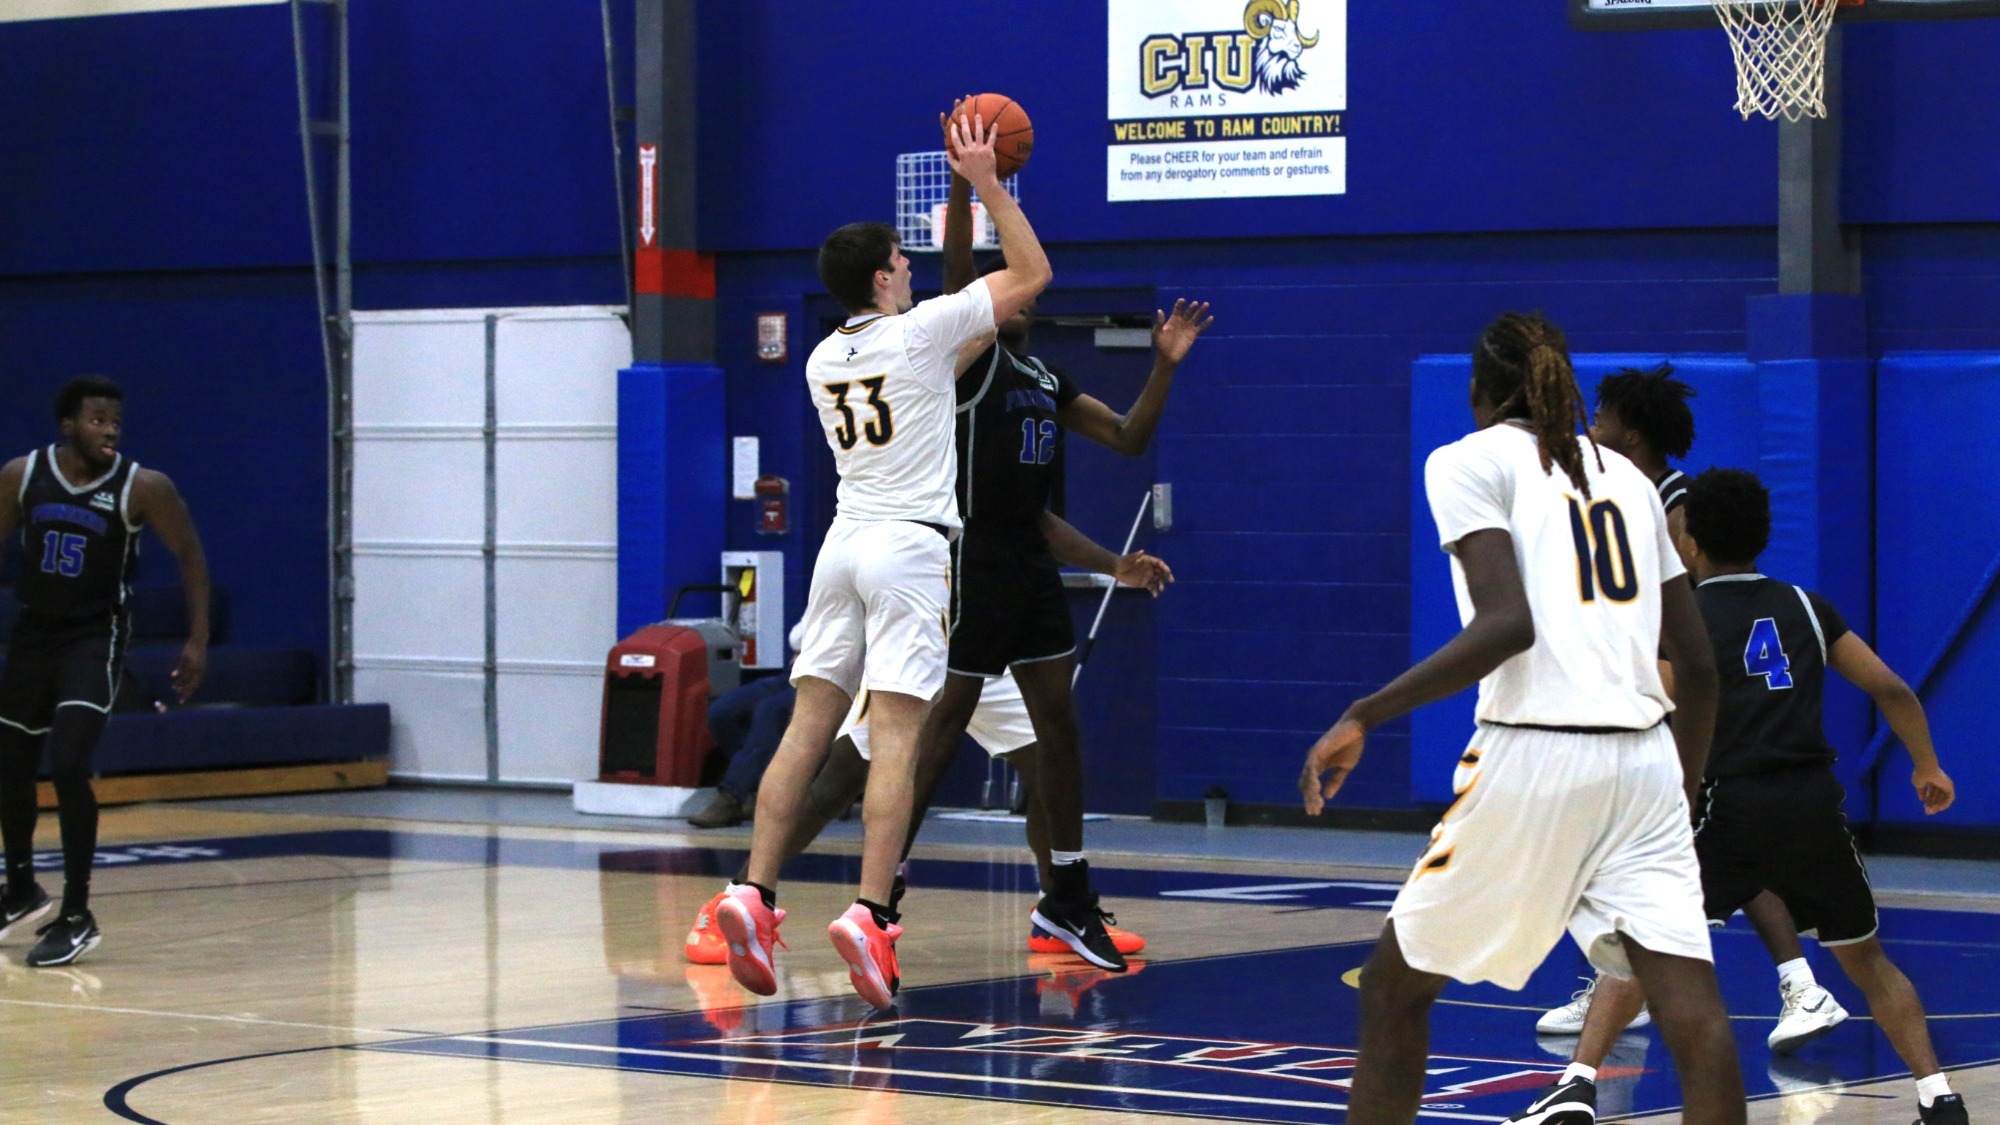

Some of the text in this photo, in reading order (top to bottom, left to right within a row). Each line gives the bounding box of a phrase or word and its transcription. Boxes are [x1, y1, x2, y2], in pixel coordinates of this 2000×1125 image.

[1140, 29, 1257, 99] CIU
[1170, 93, 1227, 108] RAMS
[1114, 114, 1341, 141] WELCOME TO RAM COUNTRY!
[1120, 164, 1332, 183] from any derogatory comments or gestures.
[1130, 147, 1323, 167] Please CHEER for your team and refrain
[823, 373, 894, 451] 33
[1020, 417, 1057, 465] 12
[40, 530, 87, 577] 15
[1562, 492, 1639, 605] 10
[1743, 617, 1794, 690] 4
